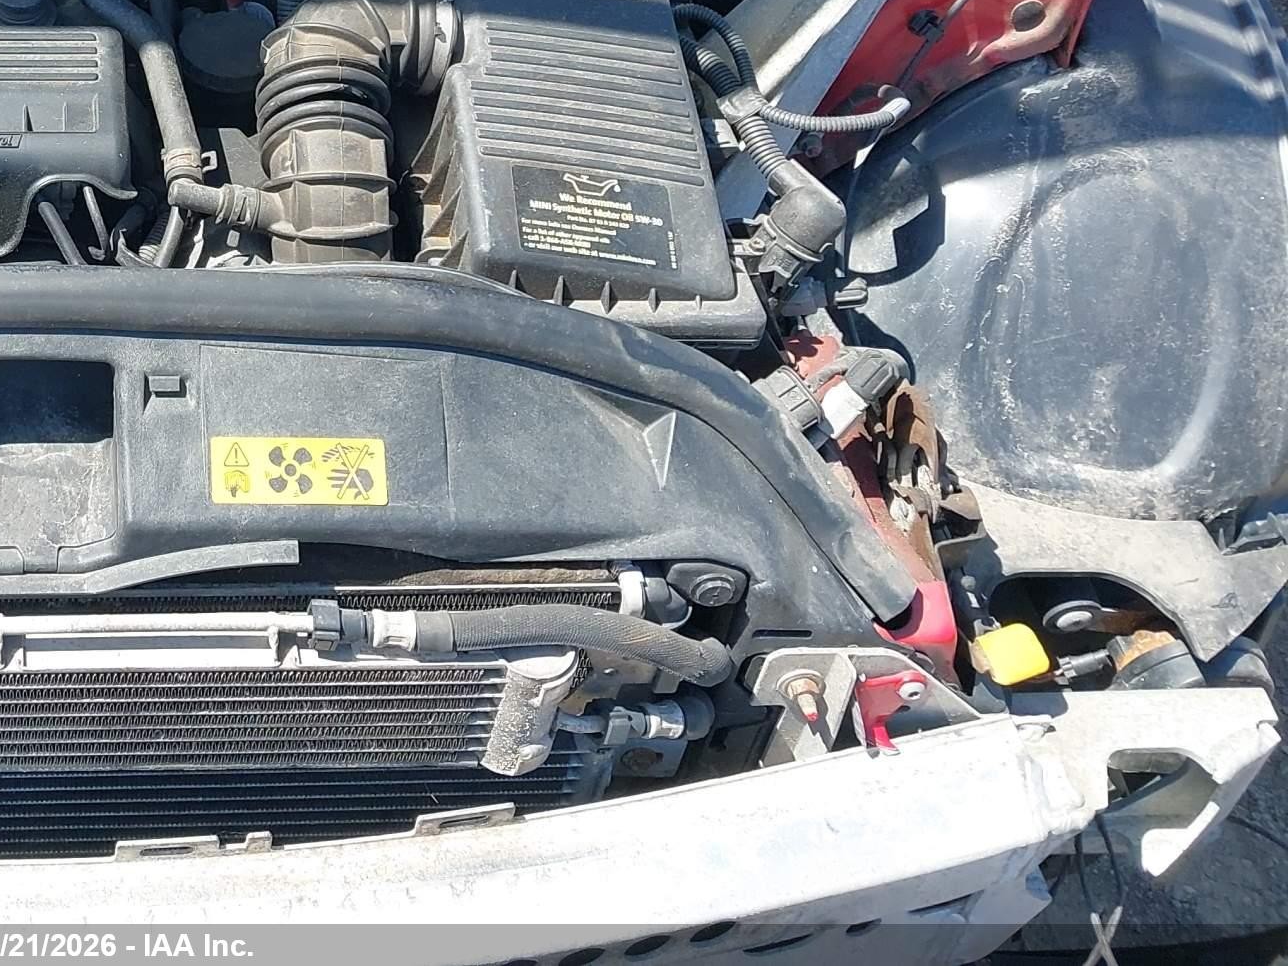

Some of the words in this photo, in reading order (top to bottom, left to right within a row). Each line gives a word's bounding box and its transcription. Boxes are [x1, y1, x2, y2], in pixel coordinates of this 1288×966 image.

[529, 199, 552, 210] MINI
[552, 202, 593, 216] Synthetic
[593, 208, 621, 220] Motor
[621, 212, 634, 222] Oil
[559, 193, 576, 203] We
[576, 194, 632, 211] Recommend
